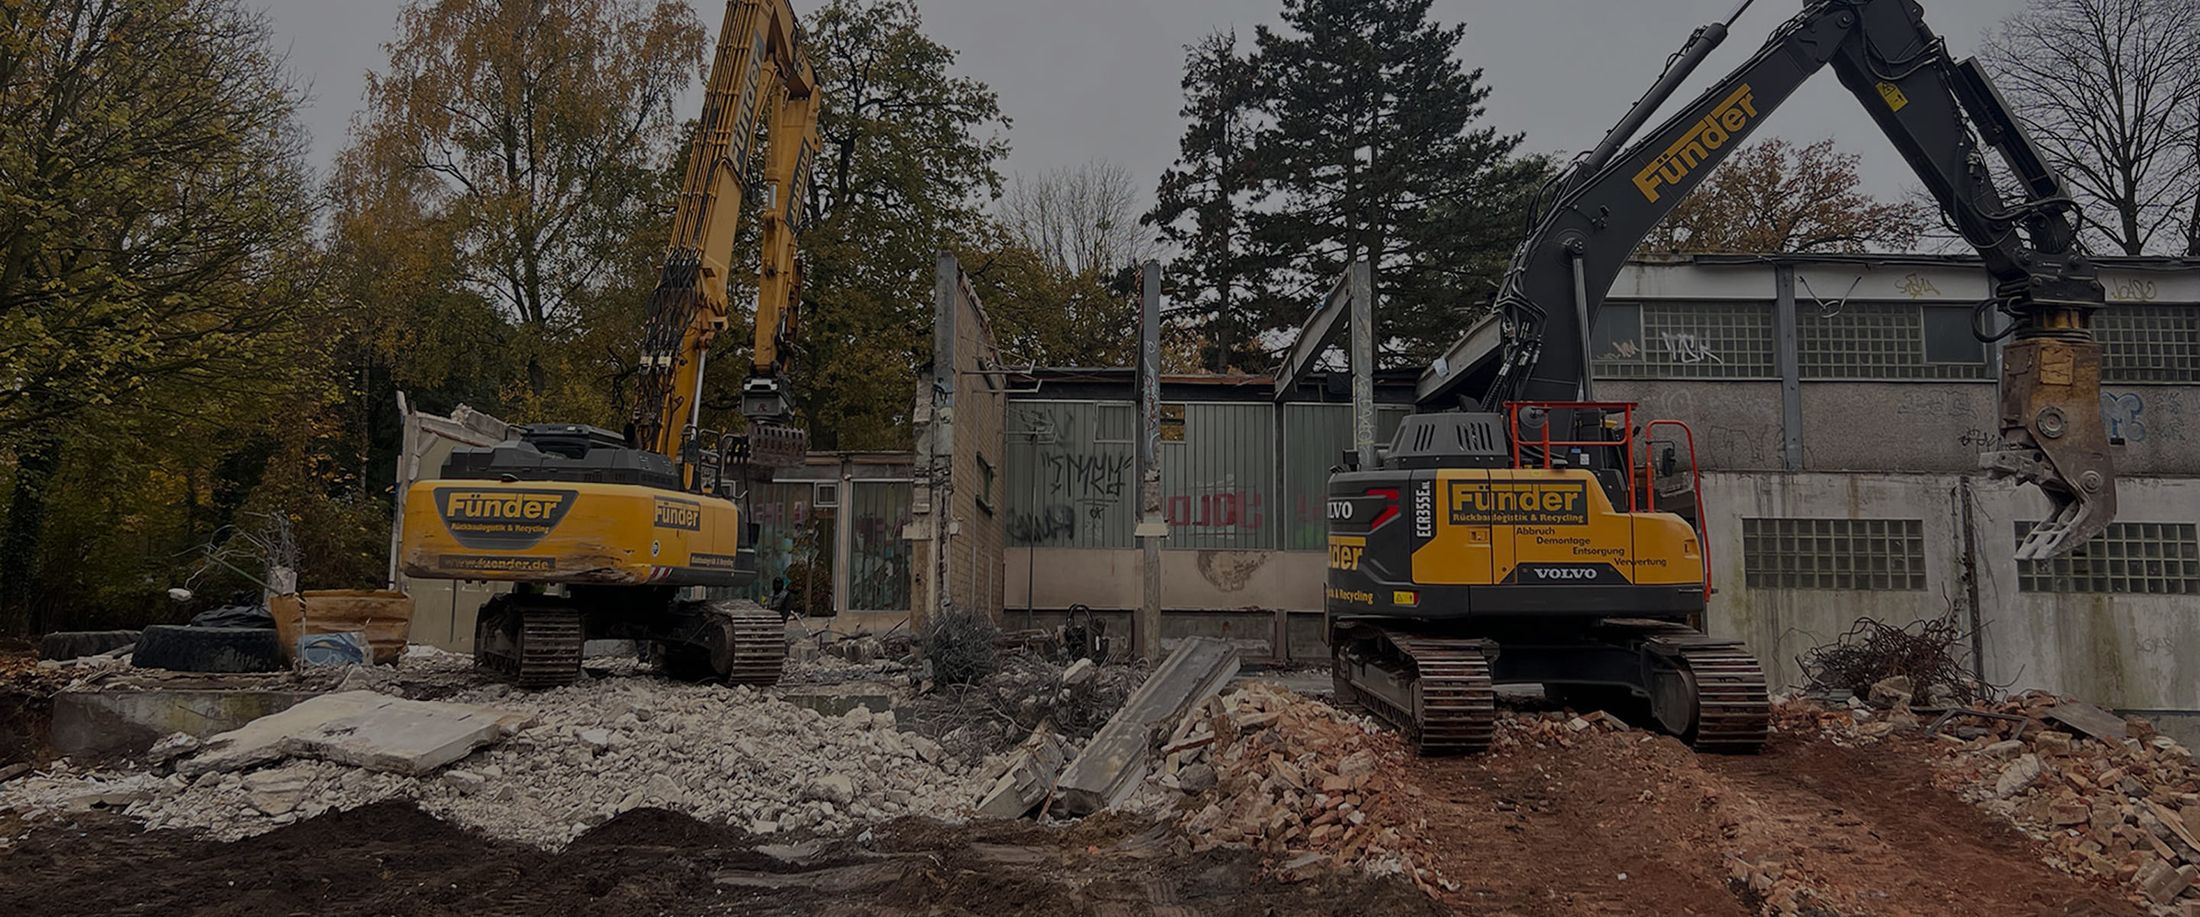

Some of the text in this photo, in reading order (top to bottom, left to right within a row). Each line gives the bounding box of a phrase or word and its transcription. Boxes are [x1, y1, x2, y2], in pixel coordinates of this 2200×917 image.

[1632, 83, 1758, 203] Fünder
[1453, 484, 1583, 511] Fünder
[447, 492, 563, 519] Fünder
[655, 500, 700, 527] Fünder
[1540, 514, 1584, 523] Recycling
[1516, 527, 1555, 535] Abbruch
[1536, 537, 1591, 545] Demontage
[1573, 547, 1625, 556] Entsorgung
[1614, 558, 1667, 567] Verwertung
[1534, 568, 1597, 579] VOLVO
